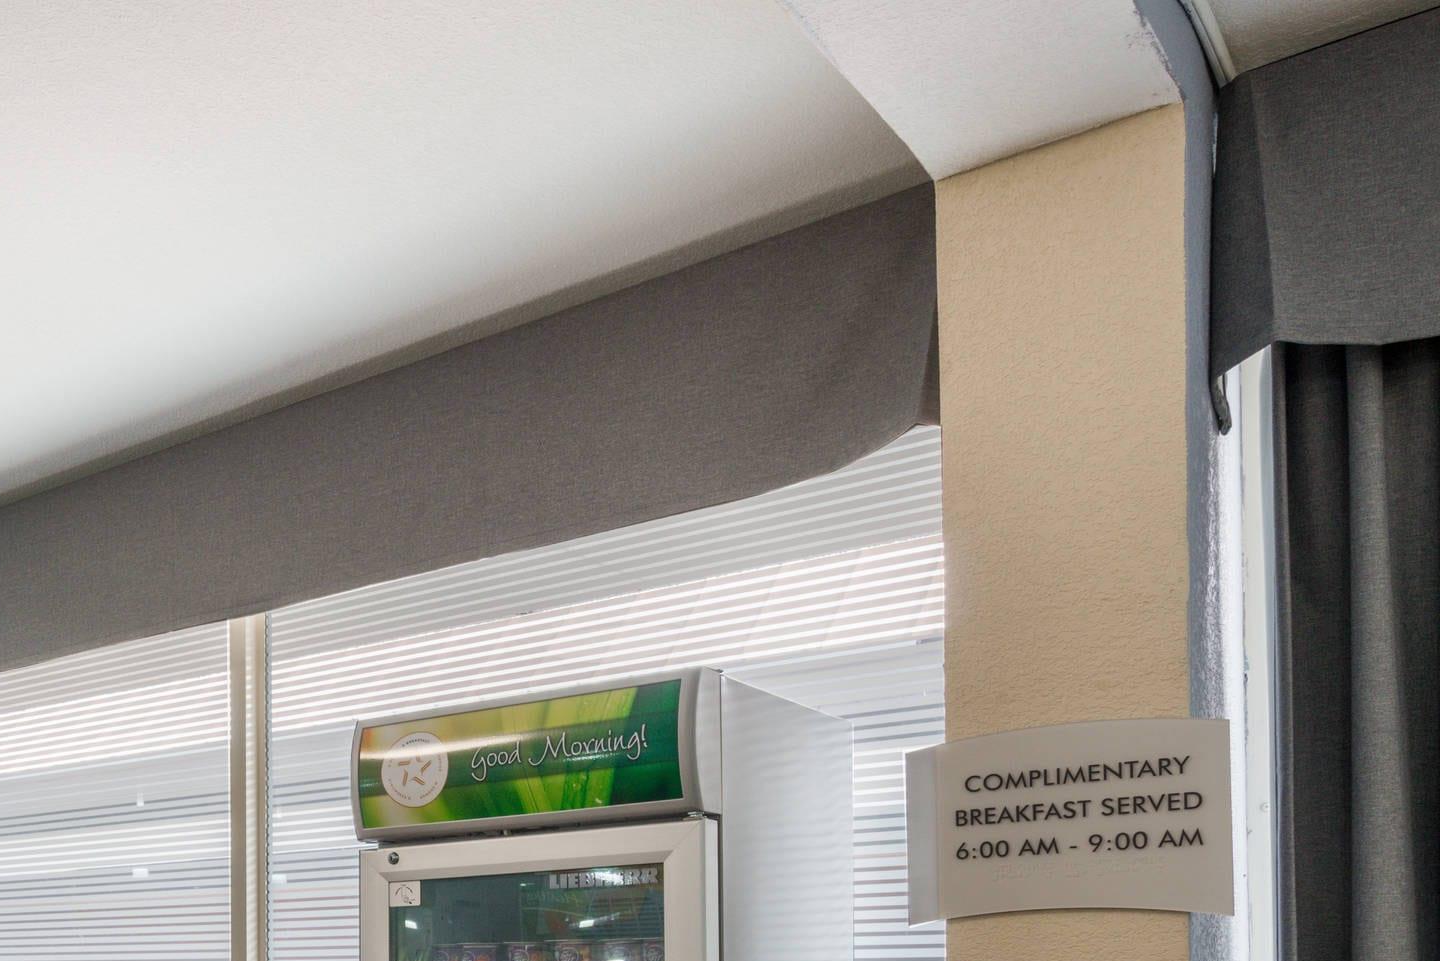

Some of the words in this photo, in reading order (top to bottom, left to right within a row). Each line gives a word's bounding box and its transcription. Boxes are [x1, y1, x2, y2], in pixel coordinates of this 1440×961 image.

[471, 740, 521, 781] Good
[528, 723, 648, 766] Morning!
[964, 755, 1190, 793] COMPLIMENTARY
[955, 799, 1092, 827] BREAKFAST
[1101, 791, 1203, 817] SERVED
[955, 839, 1010, 860] 6:00
[1018, 837, 1060, 856] AM
[1088, 831, 1148, 853] 9:00
[1158, 828, 1204, 848] AM
